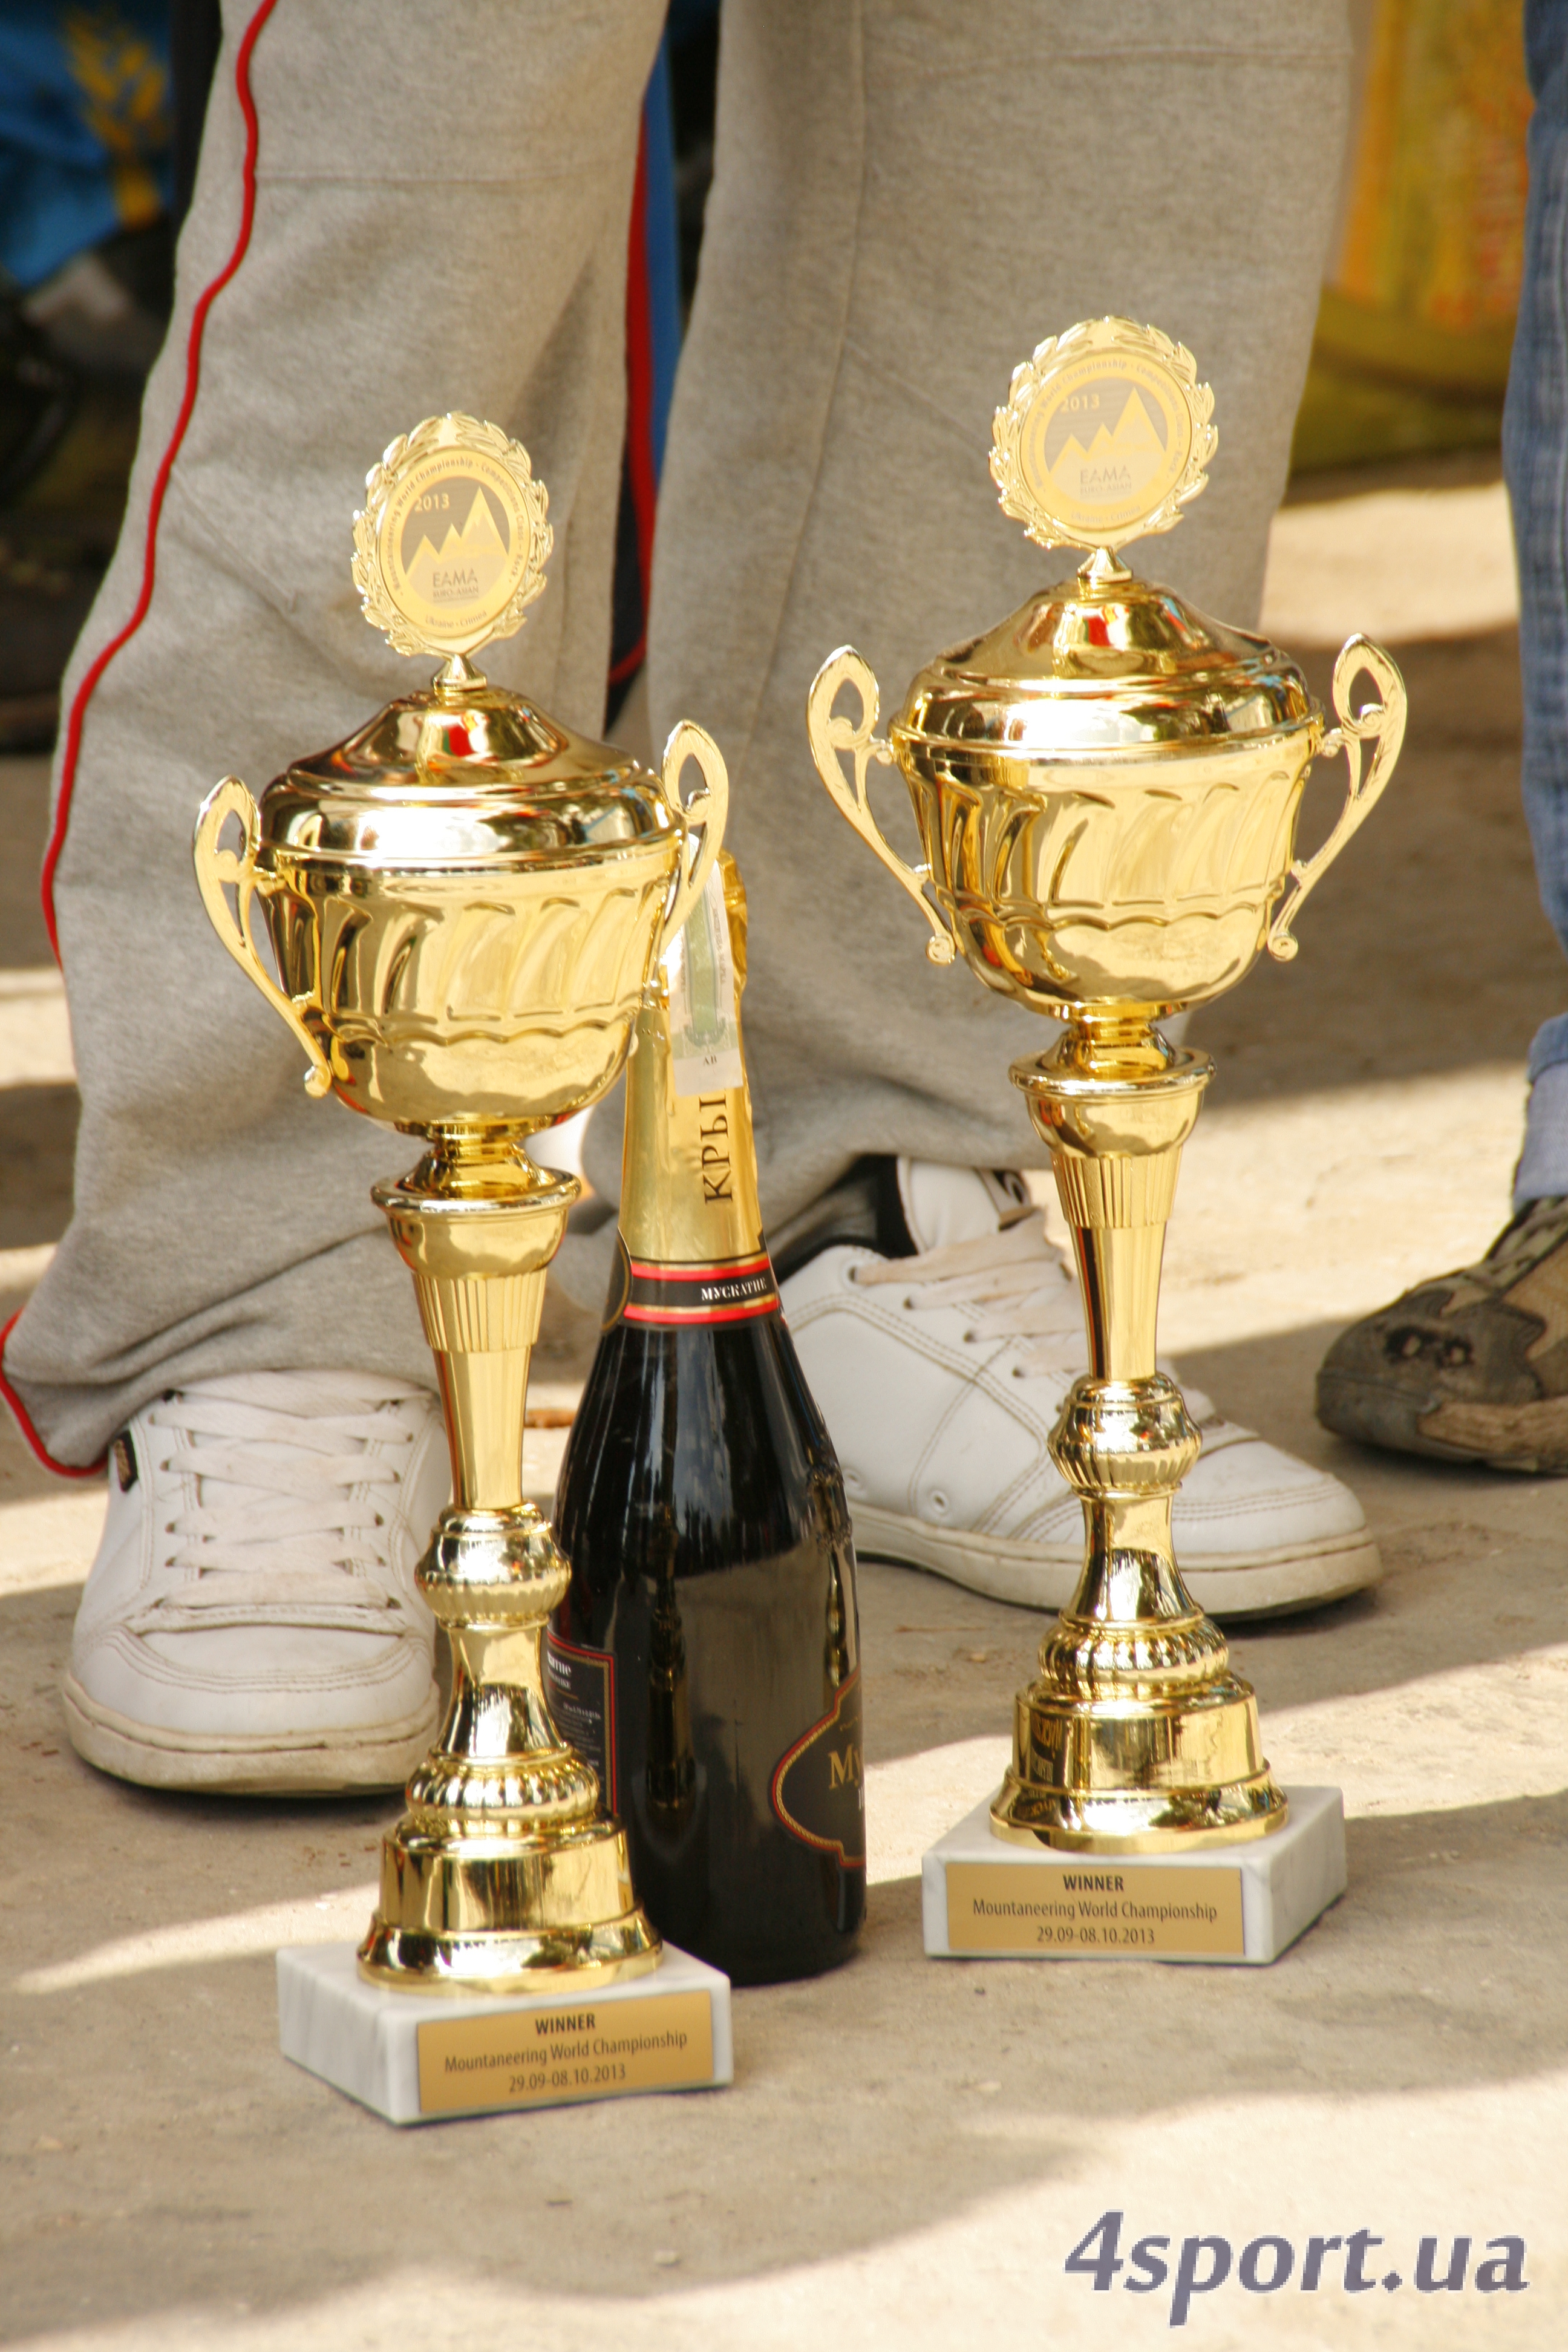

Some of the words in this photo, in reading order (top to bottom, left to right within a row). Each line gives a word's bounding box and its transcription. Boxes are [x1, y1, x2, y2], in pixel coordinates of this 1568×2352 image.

[1060, 394, 1100, 415] 2013
[396, 480, 416, 508] World
[415, 456, 474, 483] Championship
[1080, 465, 1131, 485] EAMA
[414, 491, 451, 513] 2013
[433, 567, 479, 588] EAMA
[1062, 1873, 1125, 1892] WINNER
[972, 1898, 1076, 1921] Mountaneering
[1077, 1900, 1118, 1919] World
[1121, 1901, 1218, 1923] Championship
[1037, 1926, 1155, 1944] 29.09-08.10.2013
[535, 2012, 596, 2036] WINNER
[444, 2045, 548, 2073] Mountaneering
[550, 2039, 590, 2062] World
[592, 2030, 687, 2056] Championship
[508, 2062, 626, 2094] 29.09-08.10.2013
